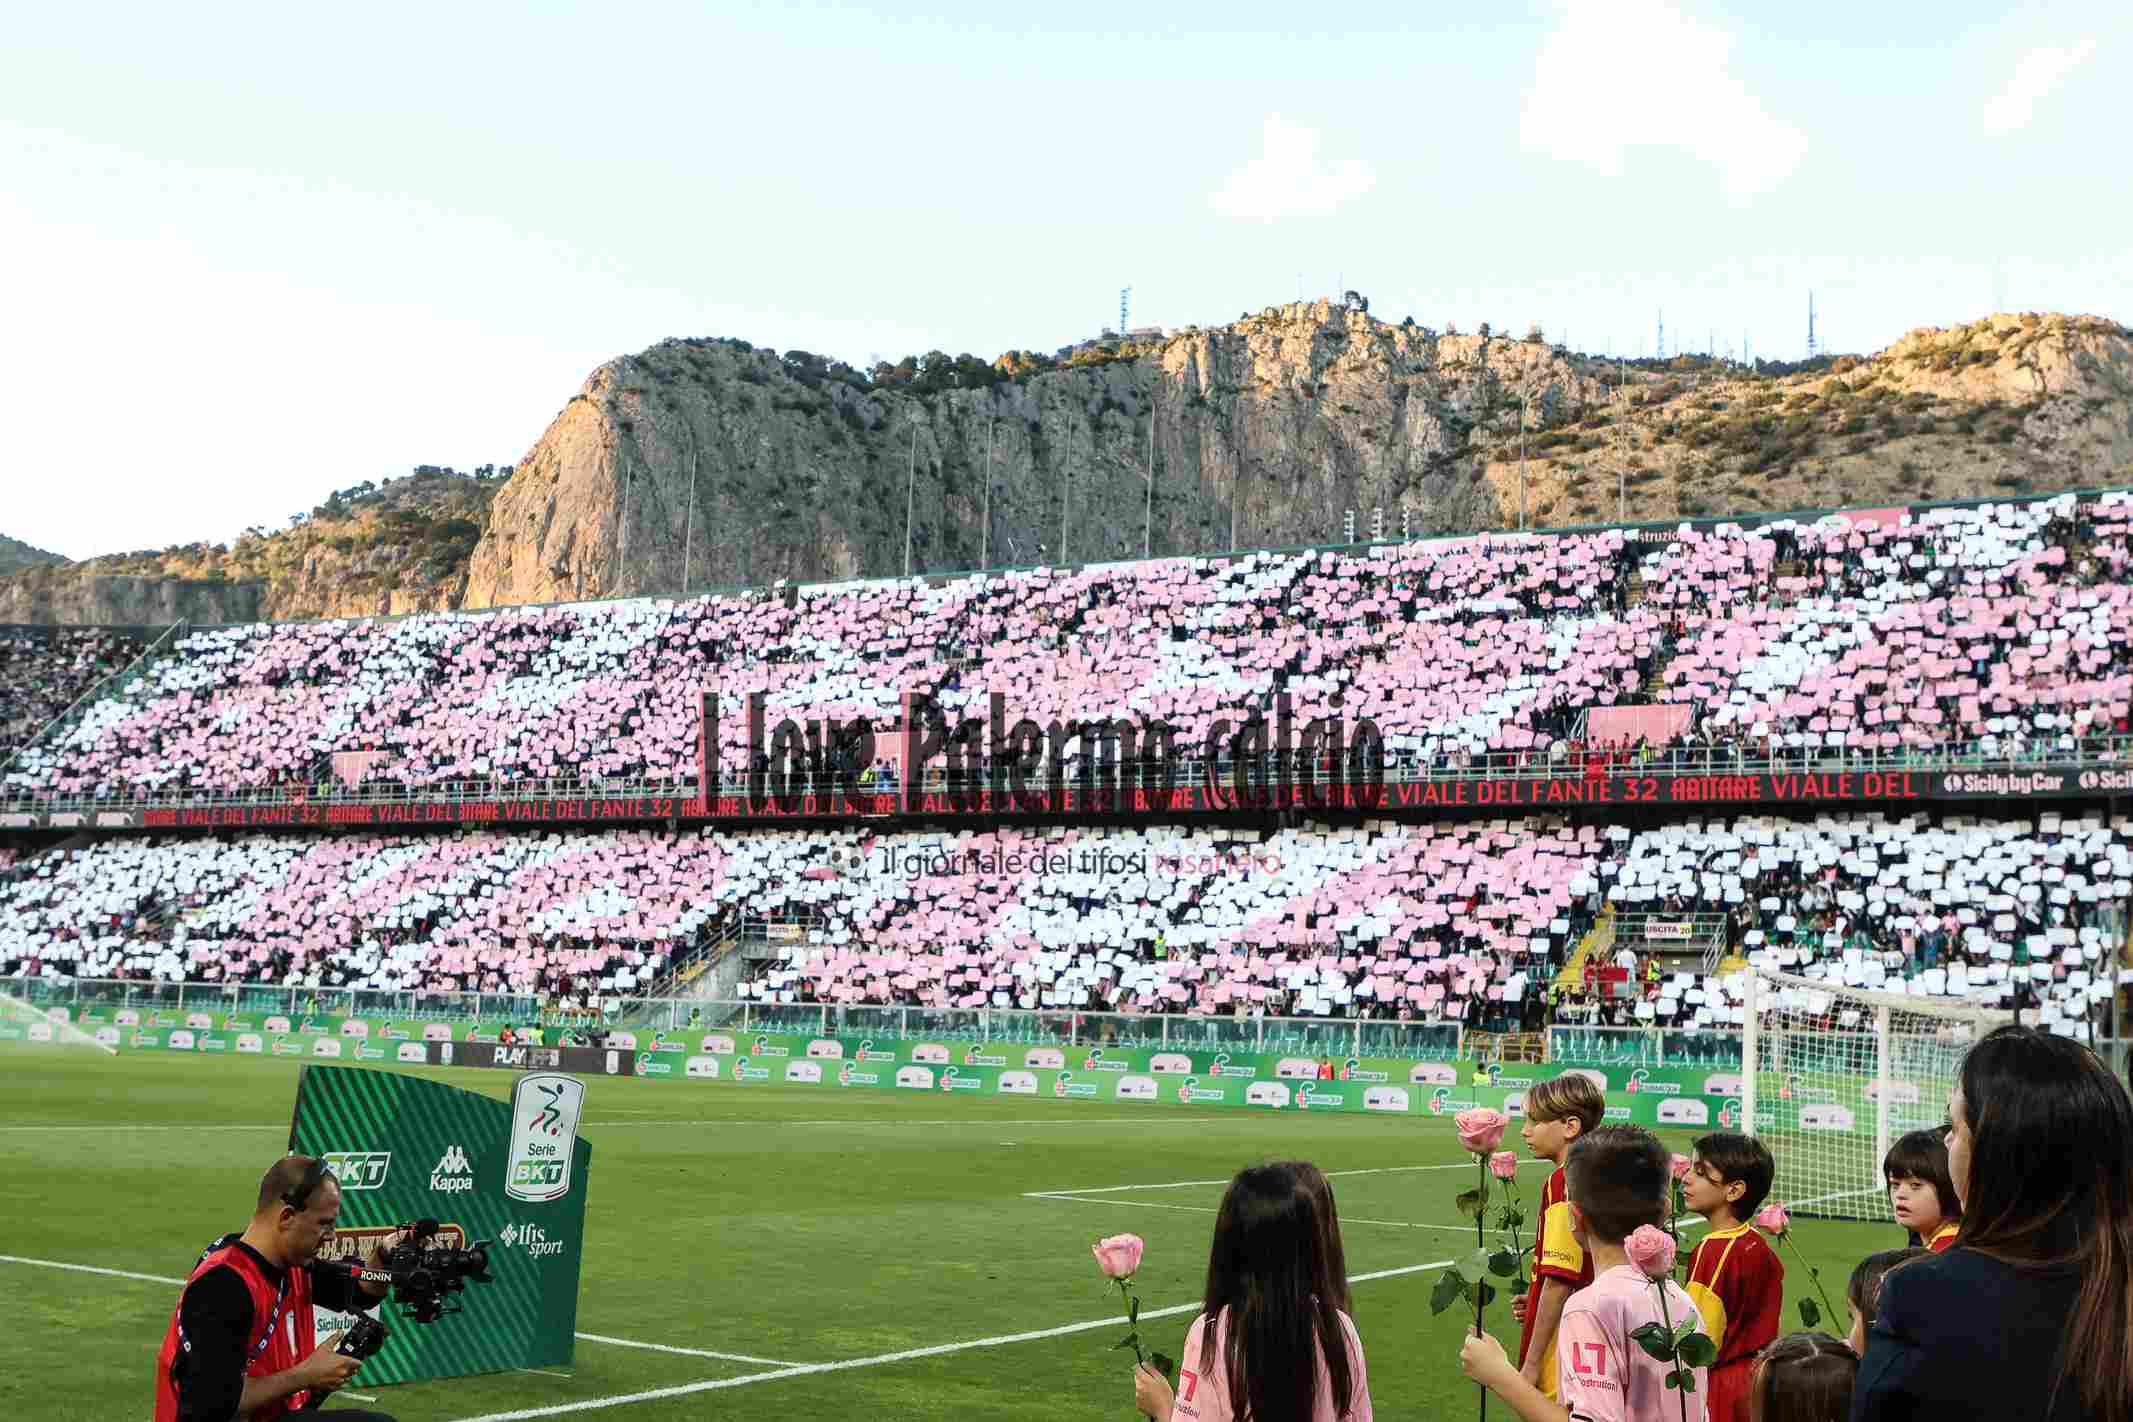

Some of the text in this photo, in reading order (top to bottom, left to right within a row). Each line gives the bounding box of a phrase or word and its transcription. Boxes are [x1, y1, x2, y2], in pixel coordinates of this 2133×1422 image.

[1398, 782, 1468, 805] VIALE
[1477, 781, 1523, 804] DEL
[1532, 778, 1612, 802] FANTE
[1624, 778, 1658, 801] 32
[1771, 771, 1854, 798] VIALE
[1864, 772, 1919, 798] DEL
[224, 807, 246, 824] DEL
[303, 806, 320, 823] 32
[378, 804, 418, 822] VIALE
[426, 804, 452, 820] DEL
[504, 802, 549, 820] VIALE
[556, 801, 585, 819] DEL
[592, 799, 642, 817] FANTE
[651, 799, 672, 816] 32
[528, 1143, 556, 1156] Serie
[512, 1161, 562, 1183] BKT
[430, 1174, 473, 1194] Kappa
[519, 1223, 545, 1246] Ifis
[529, 1239, 562, 1259] sport
[361, 1270, 392, 1282] RONIN
